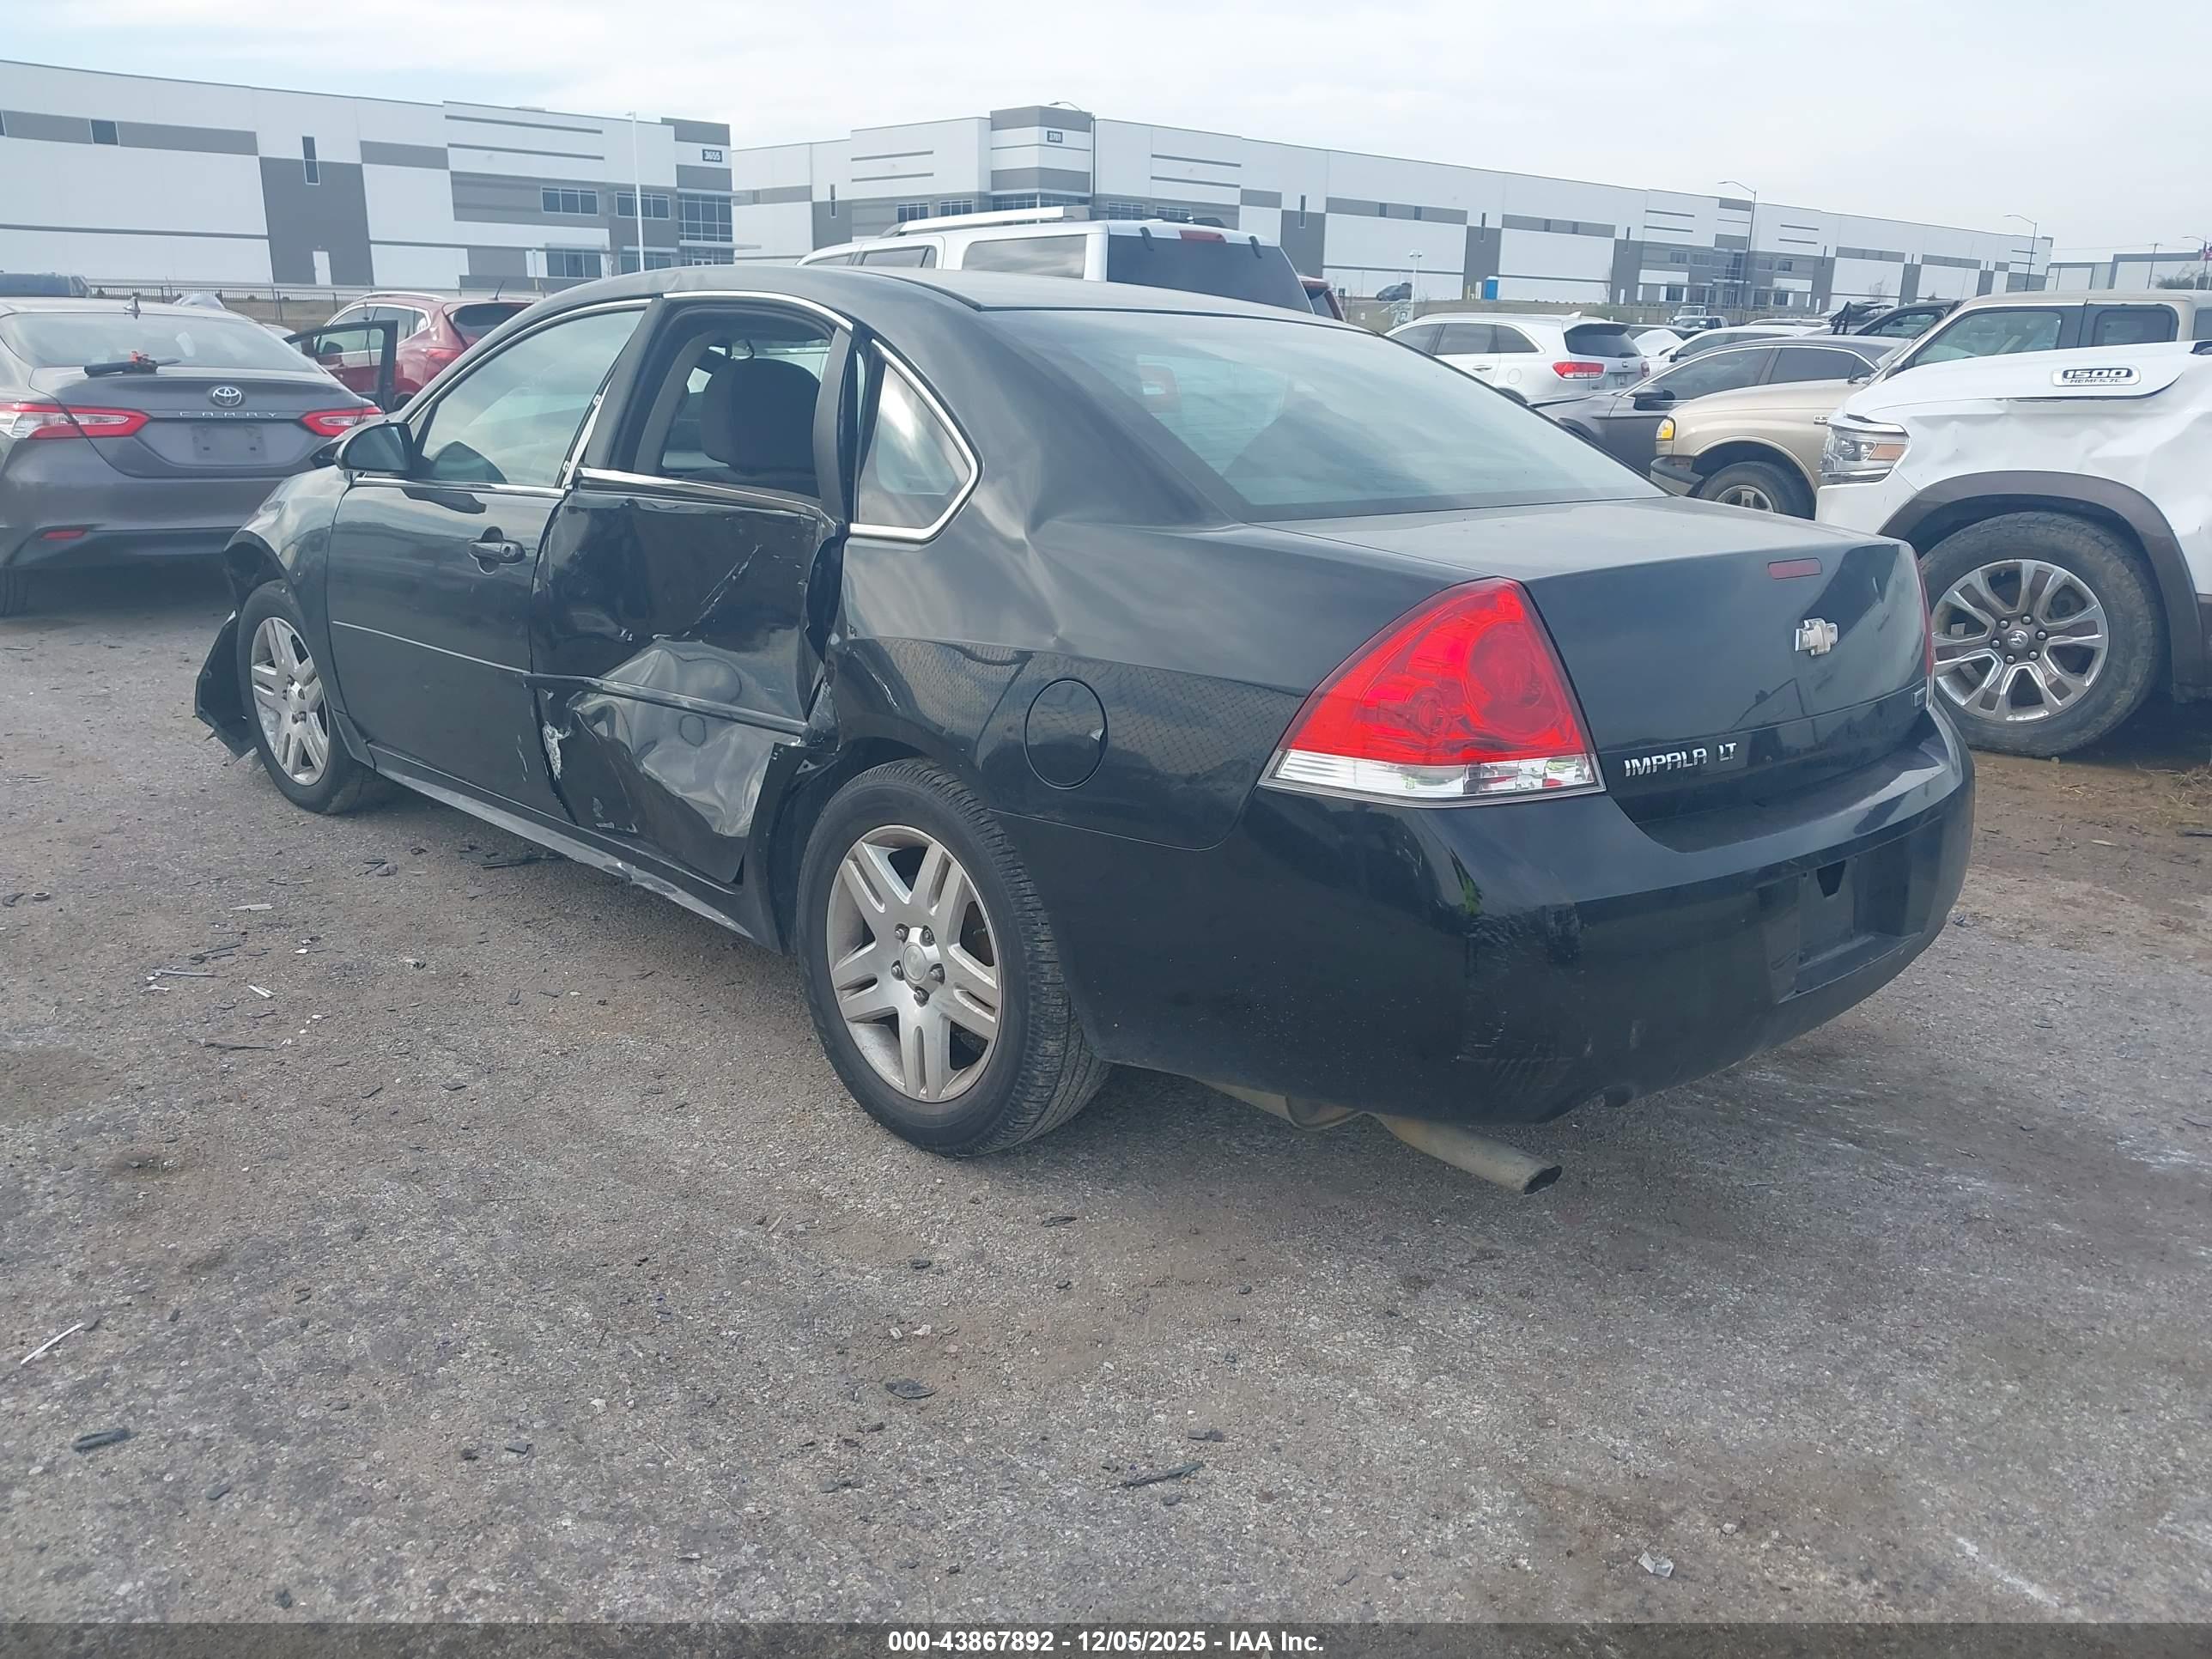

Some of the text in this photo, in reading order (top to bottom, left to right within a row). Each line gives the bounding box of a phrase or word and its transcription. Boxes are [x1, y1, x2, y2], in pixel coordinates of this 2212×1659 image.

[2066, 369, 2128, 379] 1500
[1624, 742, 1737, 777] IMPALA LT
